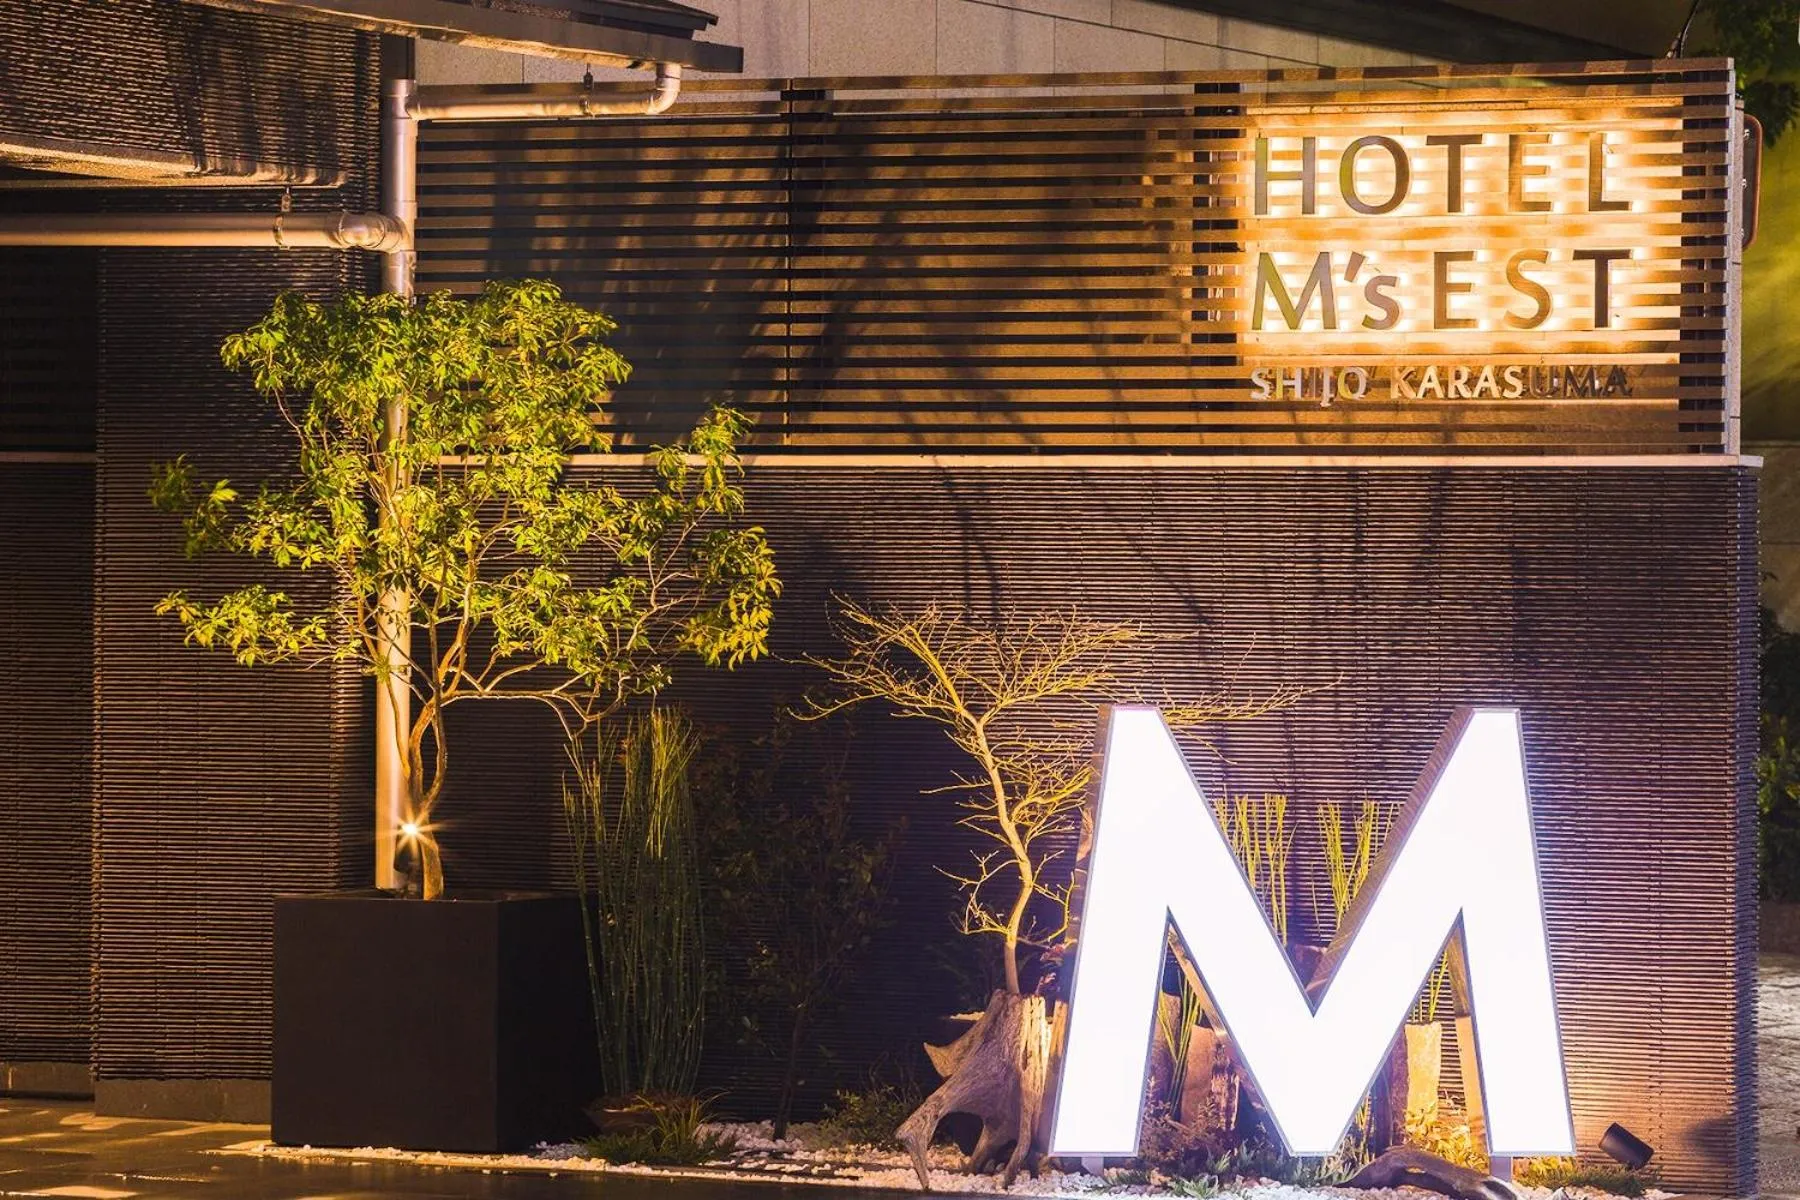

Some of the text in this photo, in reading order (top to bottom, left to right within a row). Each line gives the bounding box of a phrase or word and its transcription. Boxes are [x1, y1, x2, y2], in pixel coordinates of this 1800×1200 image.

[1253, 134, 1632, 216] HOTEL
[1251, 249, 1632, 331] M's EST
[1250, 364, 1632, 407] SHIJO KARASUMA
[1049, 706, 1576, 1156] M
